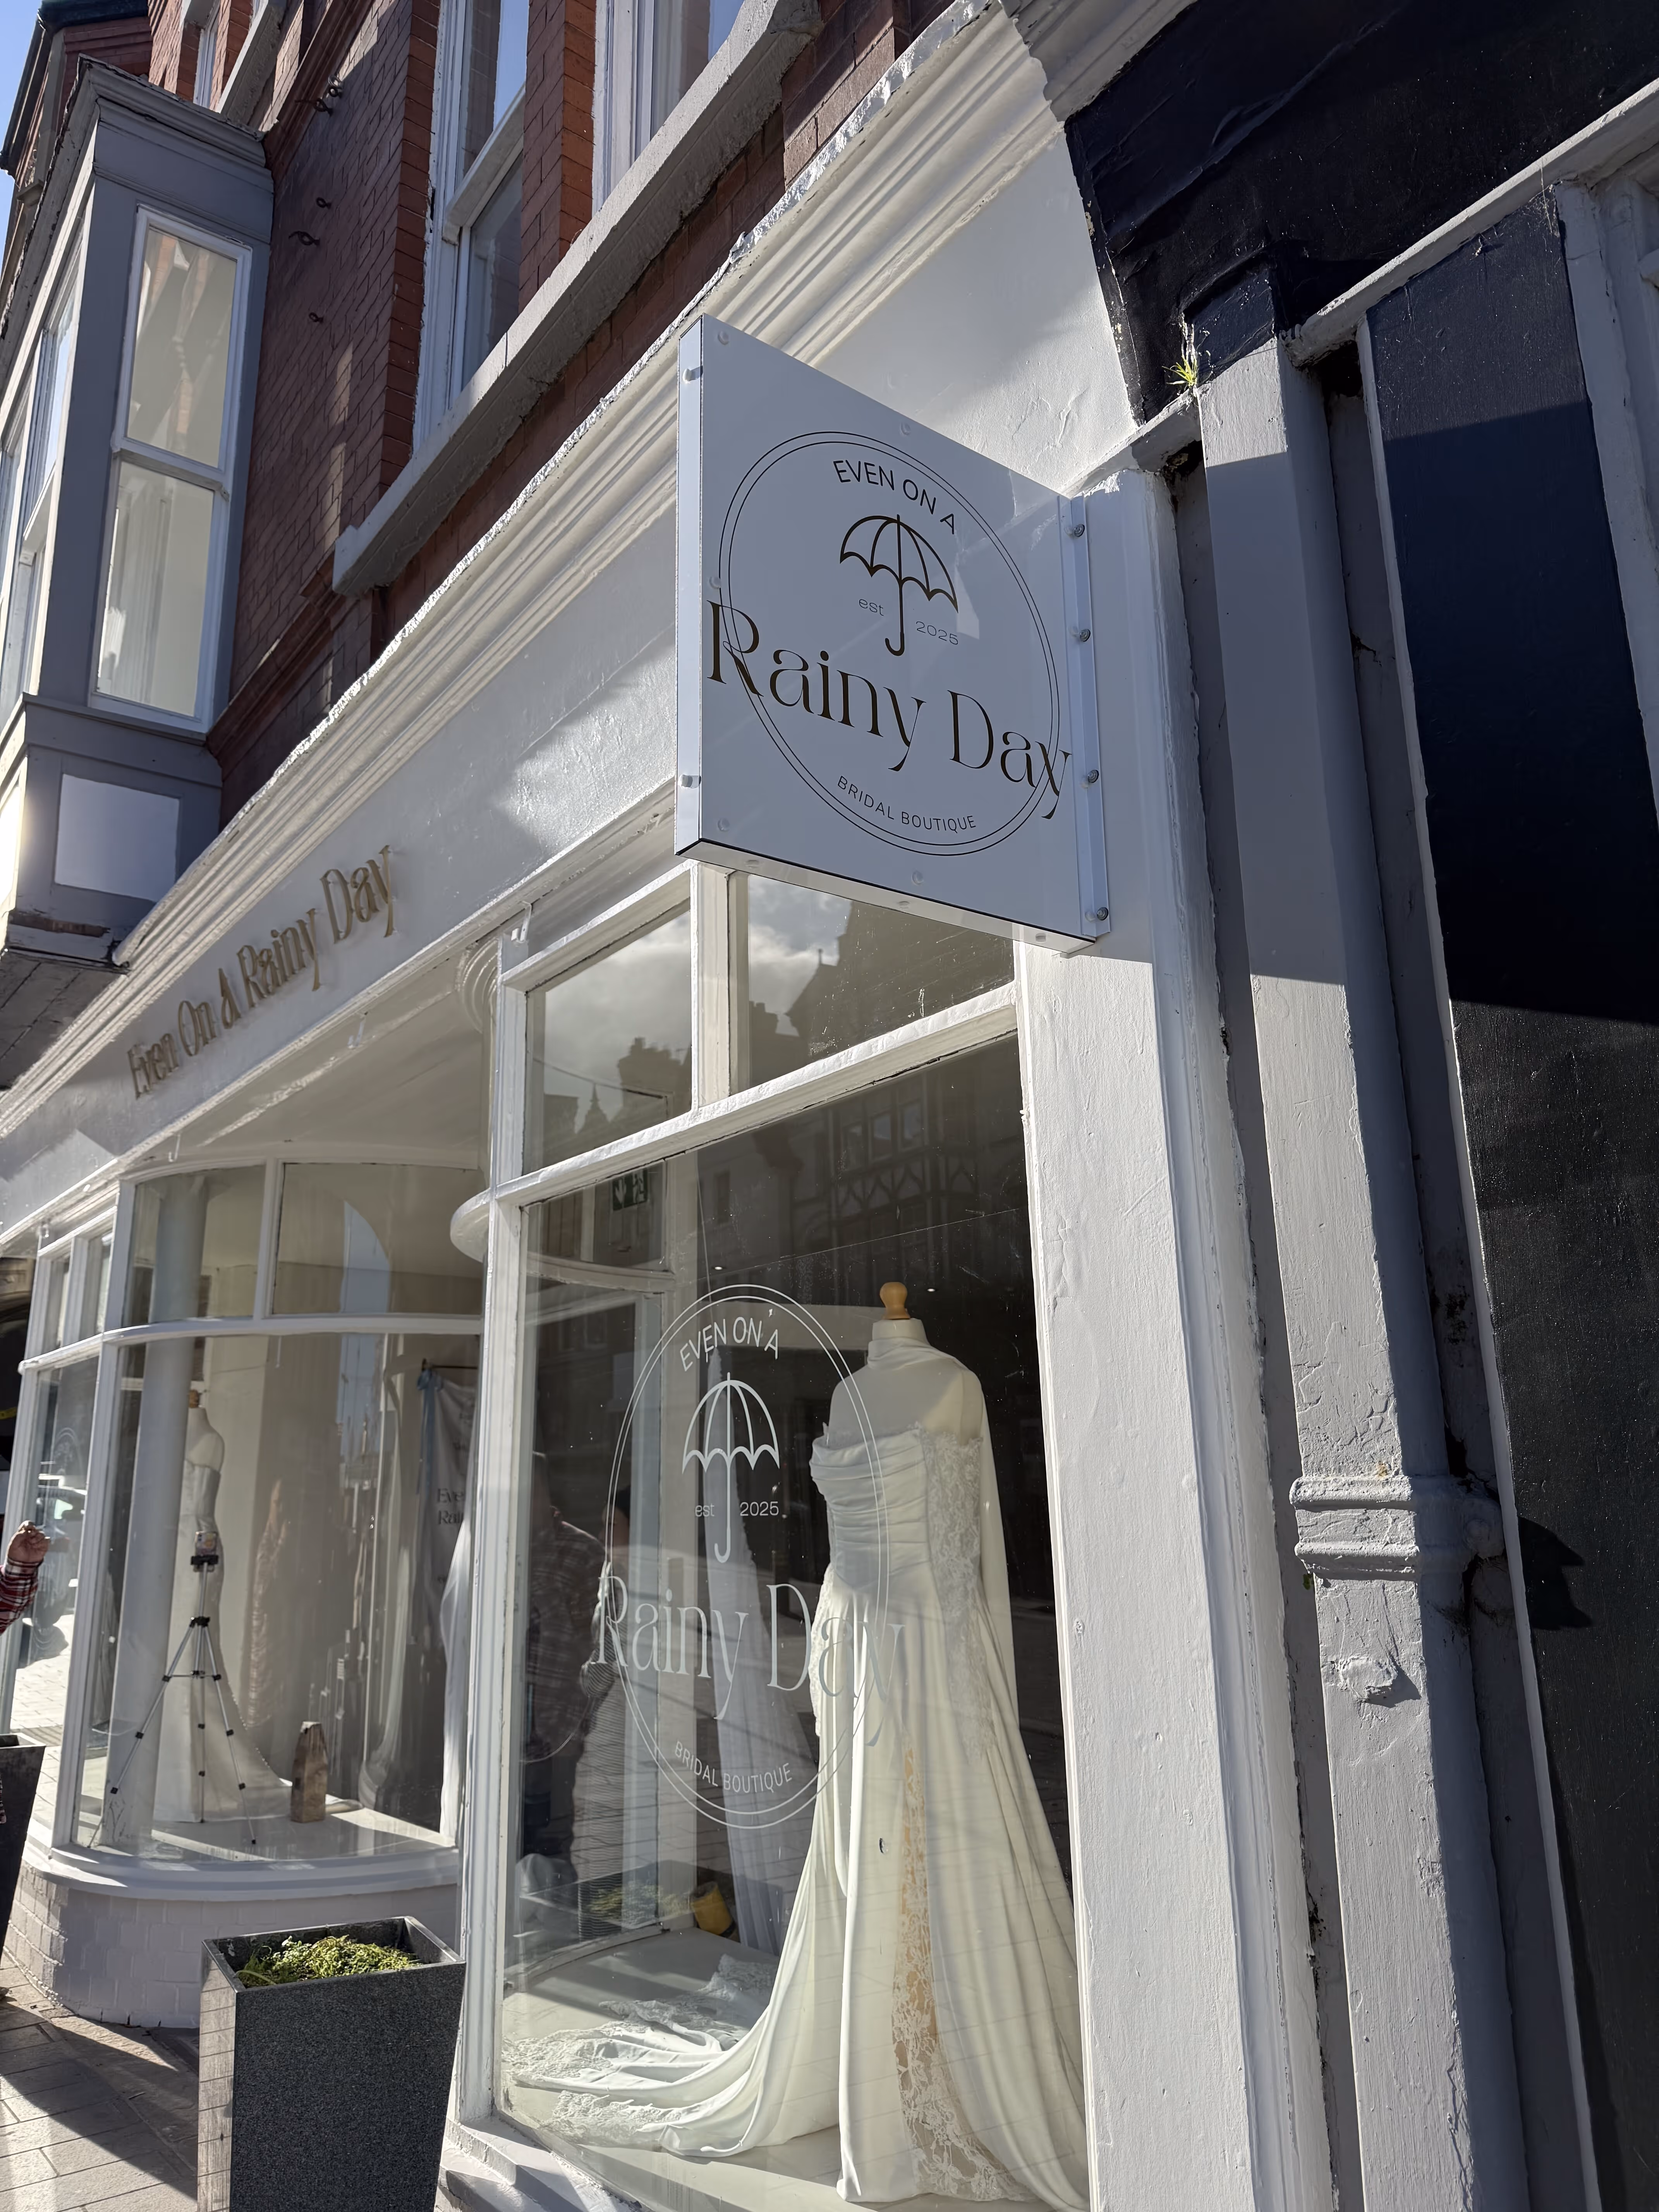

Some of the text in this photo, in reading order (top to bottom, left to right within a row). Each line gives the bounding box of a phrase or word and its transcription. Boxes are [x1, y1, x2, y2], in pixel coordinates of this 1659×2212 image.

[833, 460, 955, 534] EVEN ON A
[859, 598, 959, 646] est 2025
[706, 600, 1072, 820] Rainy Day
[837, 775, 976, 833] BRIDAL BOUTIQUE
[127, 845, 394, 1099] Even On A Rainy Day
[680, 1317, 778, 1371] EVEN ON A
[436, 1488, 464, 1504] Eve
[695, 1501, 780, 1517] est 2025
[598, 1575, 906, 1747] Rainy Day
[674, 1741, 793, 1794] BRIDAL BOUTIQUE
